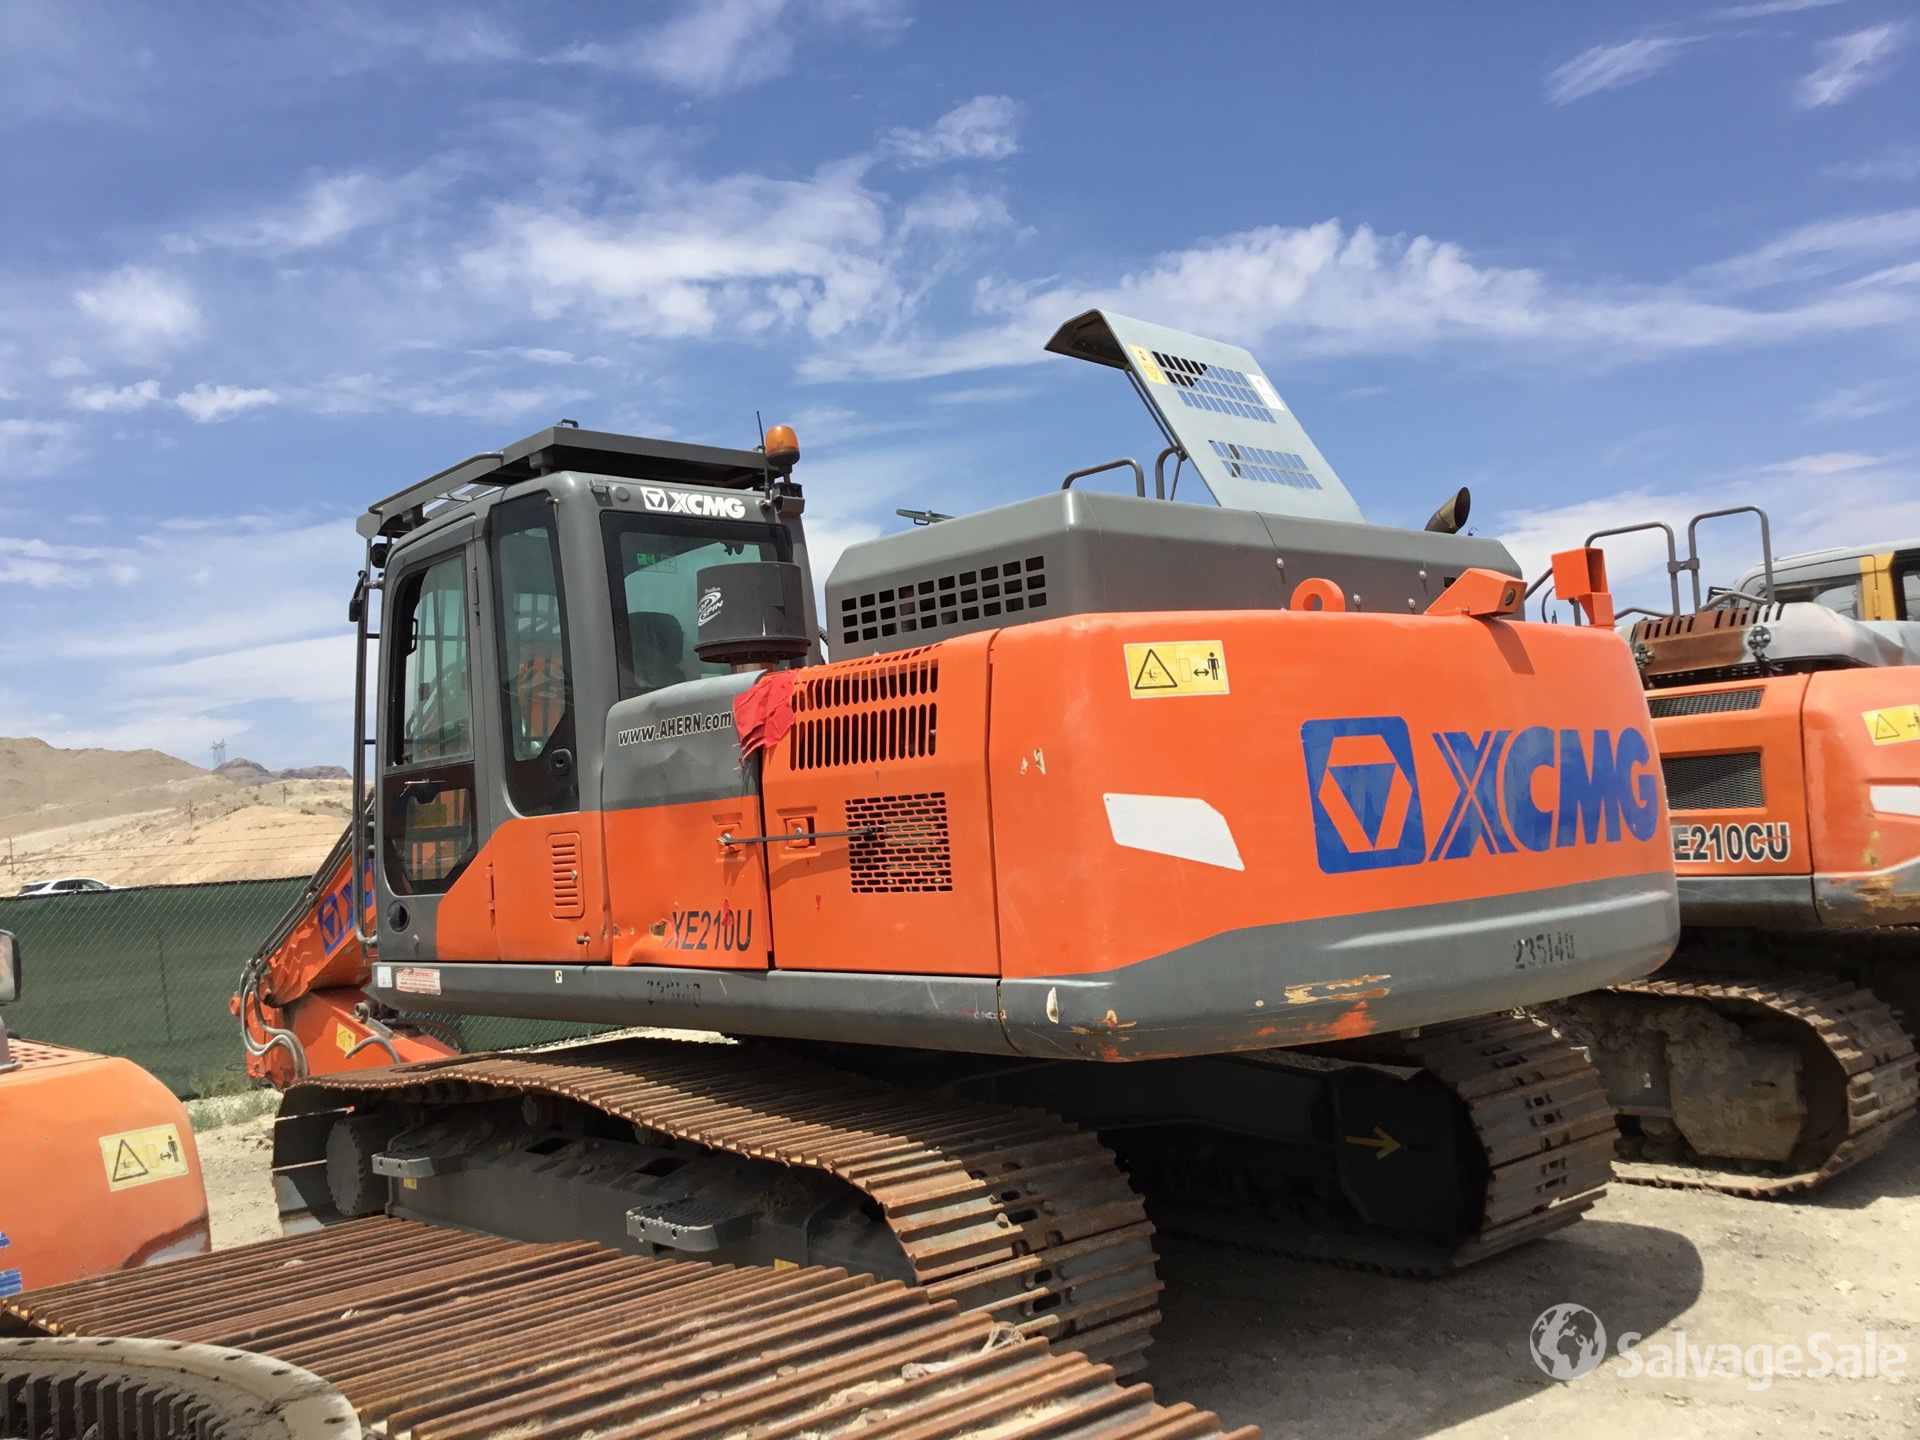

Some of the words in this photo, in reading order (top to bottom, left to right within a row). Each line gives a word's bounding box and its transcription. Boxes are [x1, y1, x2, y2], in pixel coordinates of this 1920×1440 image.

[668, 492, 746, 519] XCMG
[618, 711, 732, 746] www.AHERN.com
[1428, 726, 1659, 862] XCMG
[664, 909, 752, 951] XE210U
